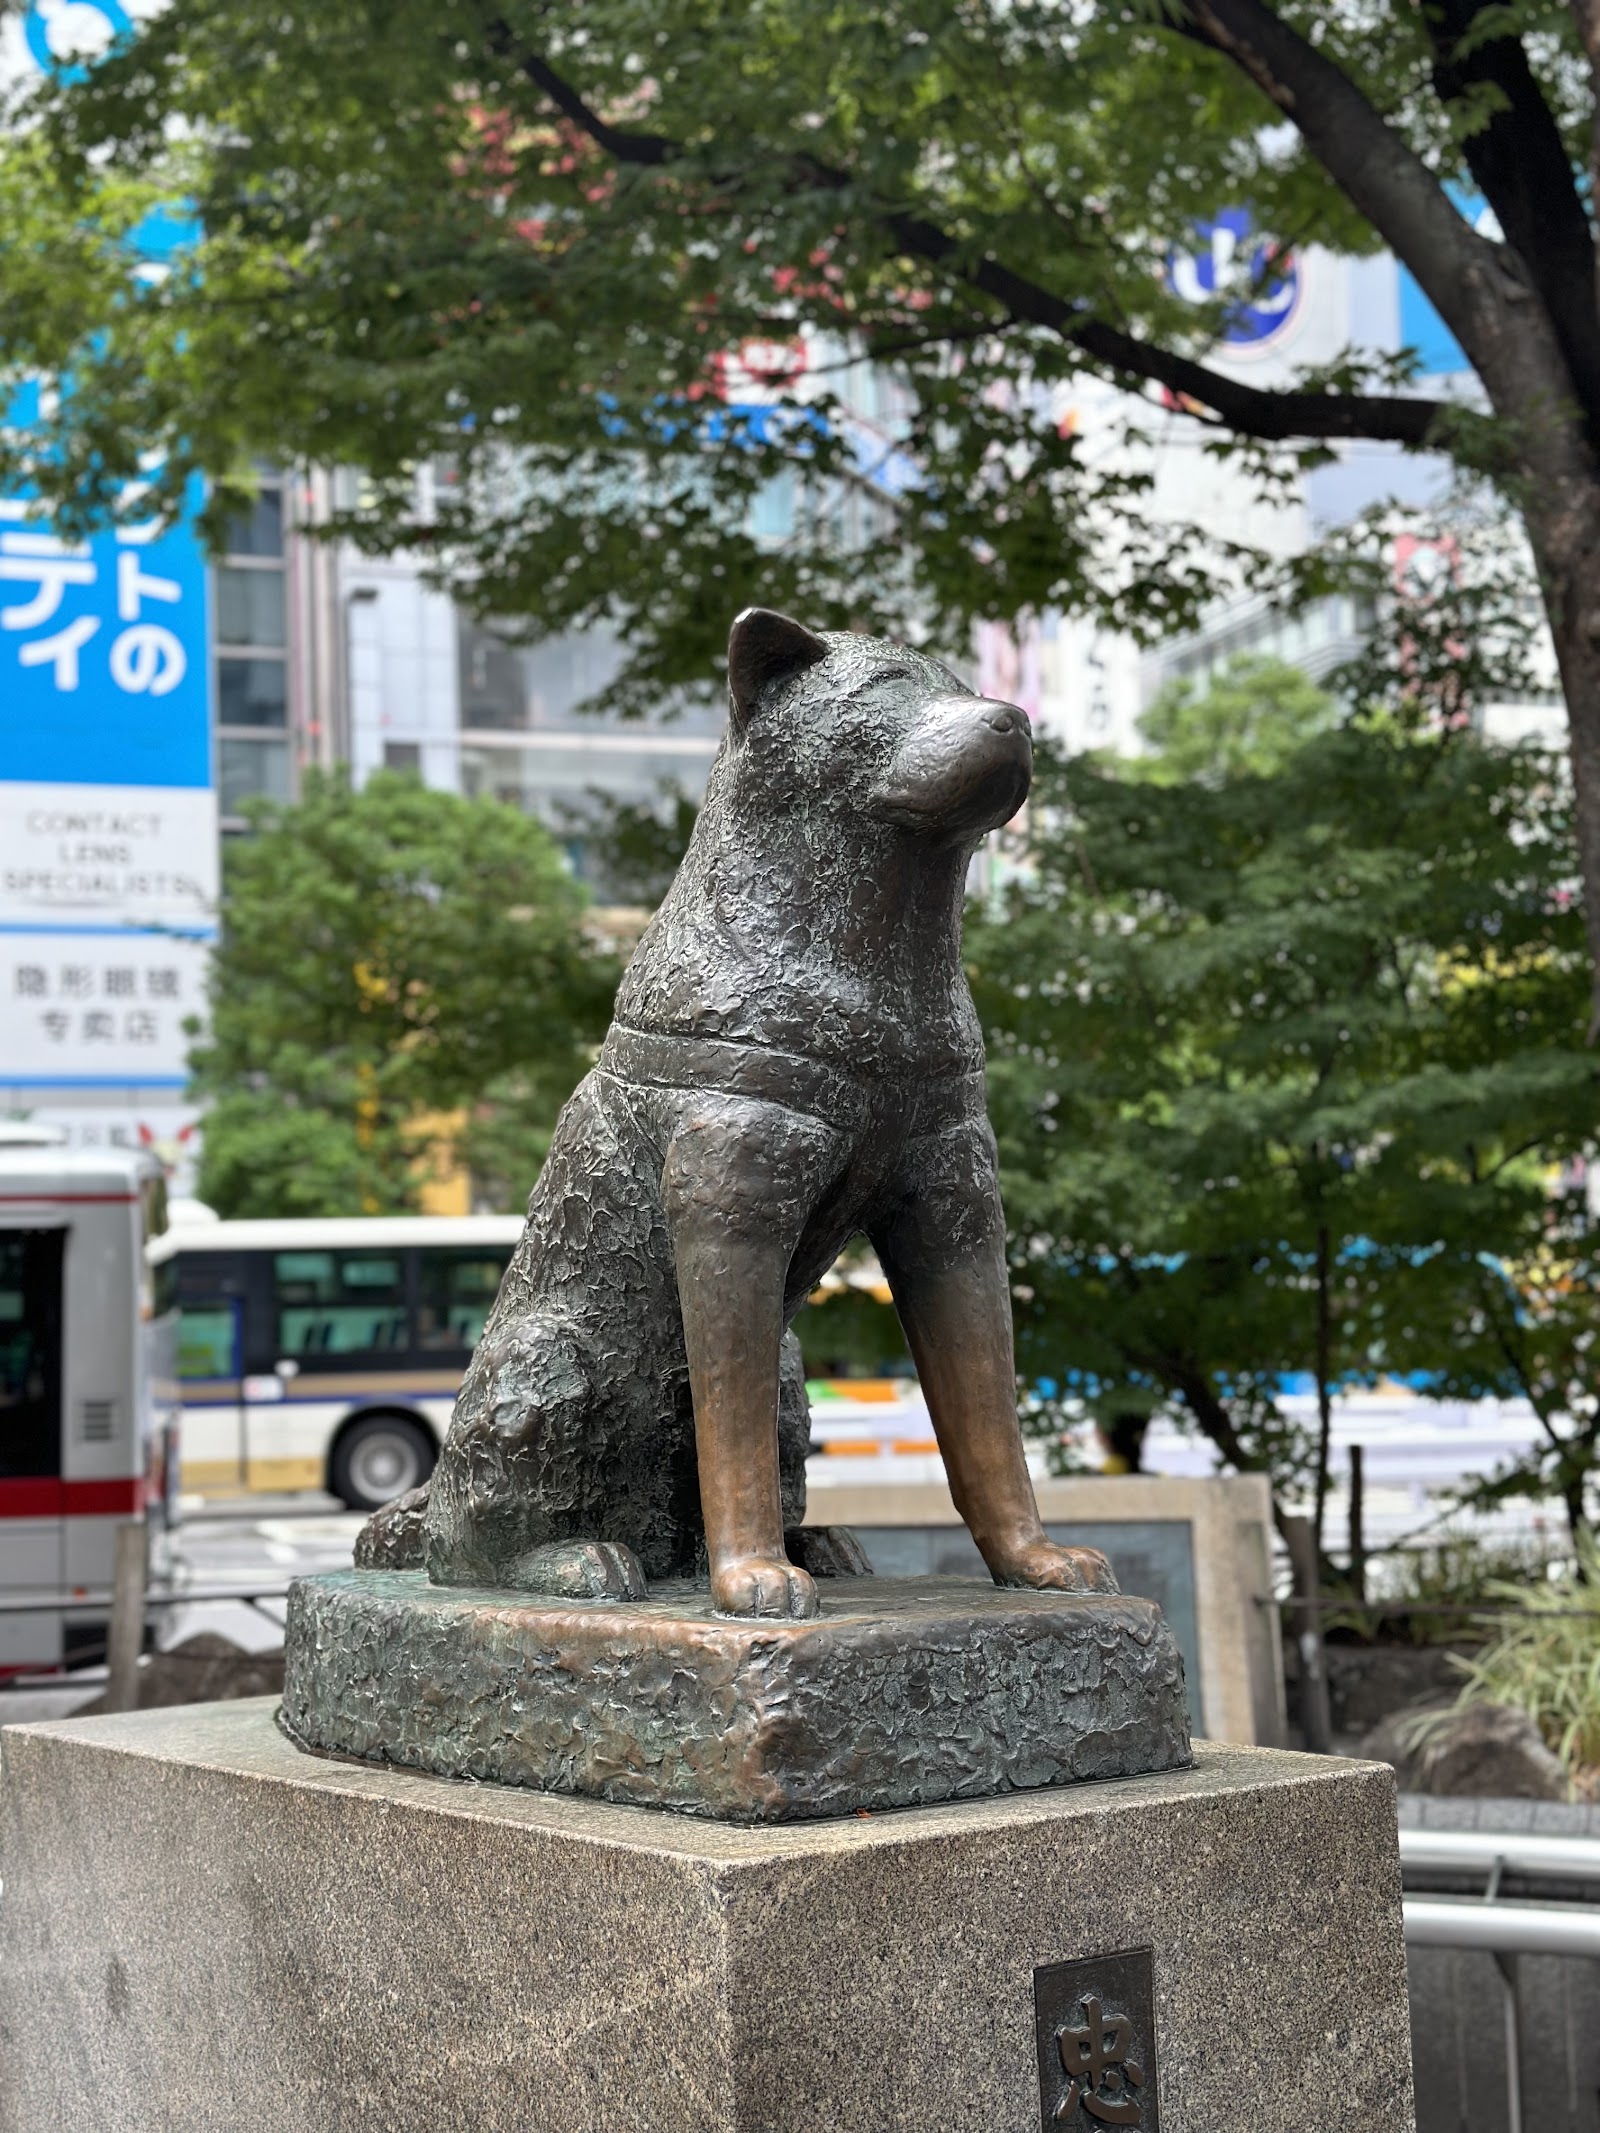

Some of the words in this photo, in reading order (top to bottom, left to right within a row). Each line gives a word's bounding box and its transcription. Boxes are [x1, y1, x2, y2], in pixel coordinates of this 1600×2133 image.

[28, 812, 162, 836] CONTACT
[60, 844, 130, 866] LENS
[1054, 1993, 1144, 2124] 忠
